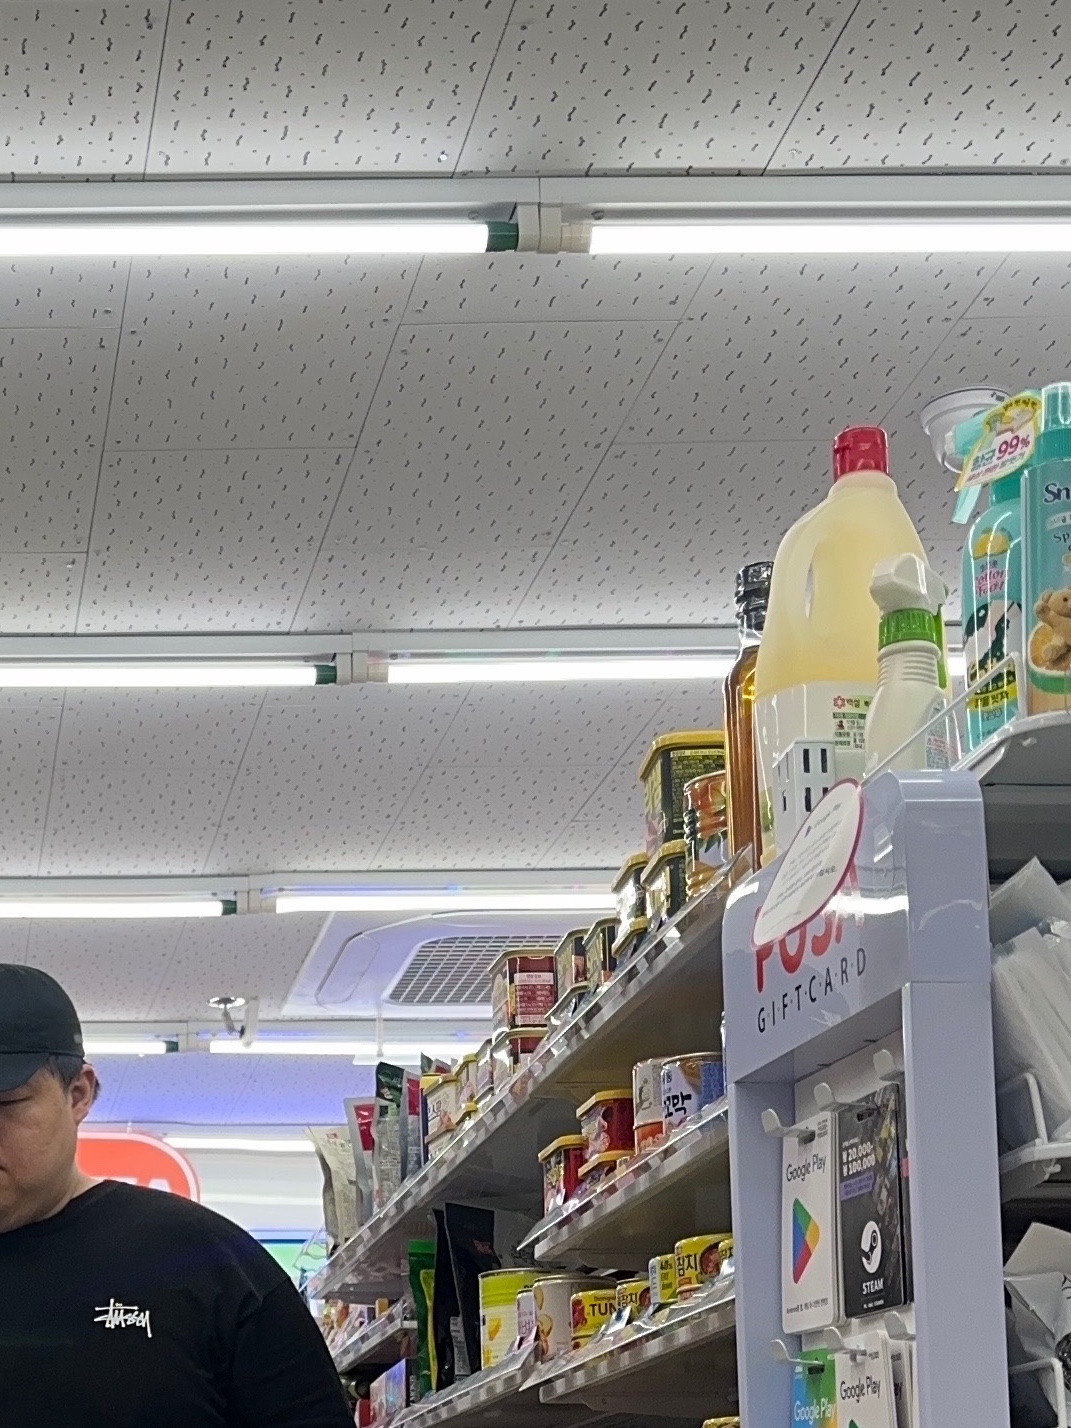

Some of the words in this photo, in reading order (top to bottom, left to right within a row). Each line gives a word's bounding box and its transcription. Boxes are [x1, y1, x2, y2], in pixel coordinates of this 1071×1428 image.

[996, 434, 1031, 461] 99%
[786, 1159, 811, 1182] Google
[812, 1153, 827, 1174] Play
[677, 1253, 698, 1276] 참치
[862, 1277, 884, 1295] STEAM
[840, 1378, 866, 1403] Google
[866, 1375, 881, 1399] Play
[794, 1399, 820, 1425] Google
